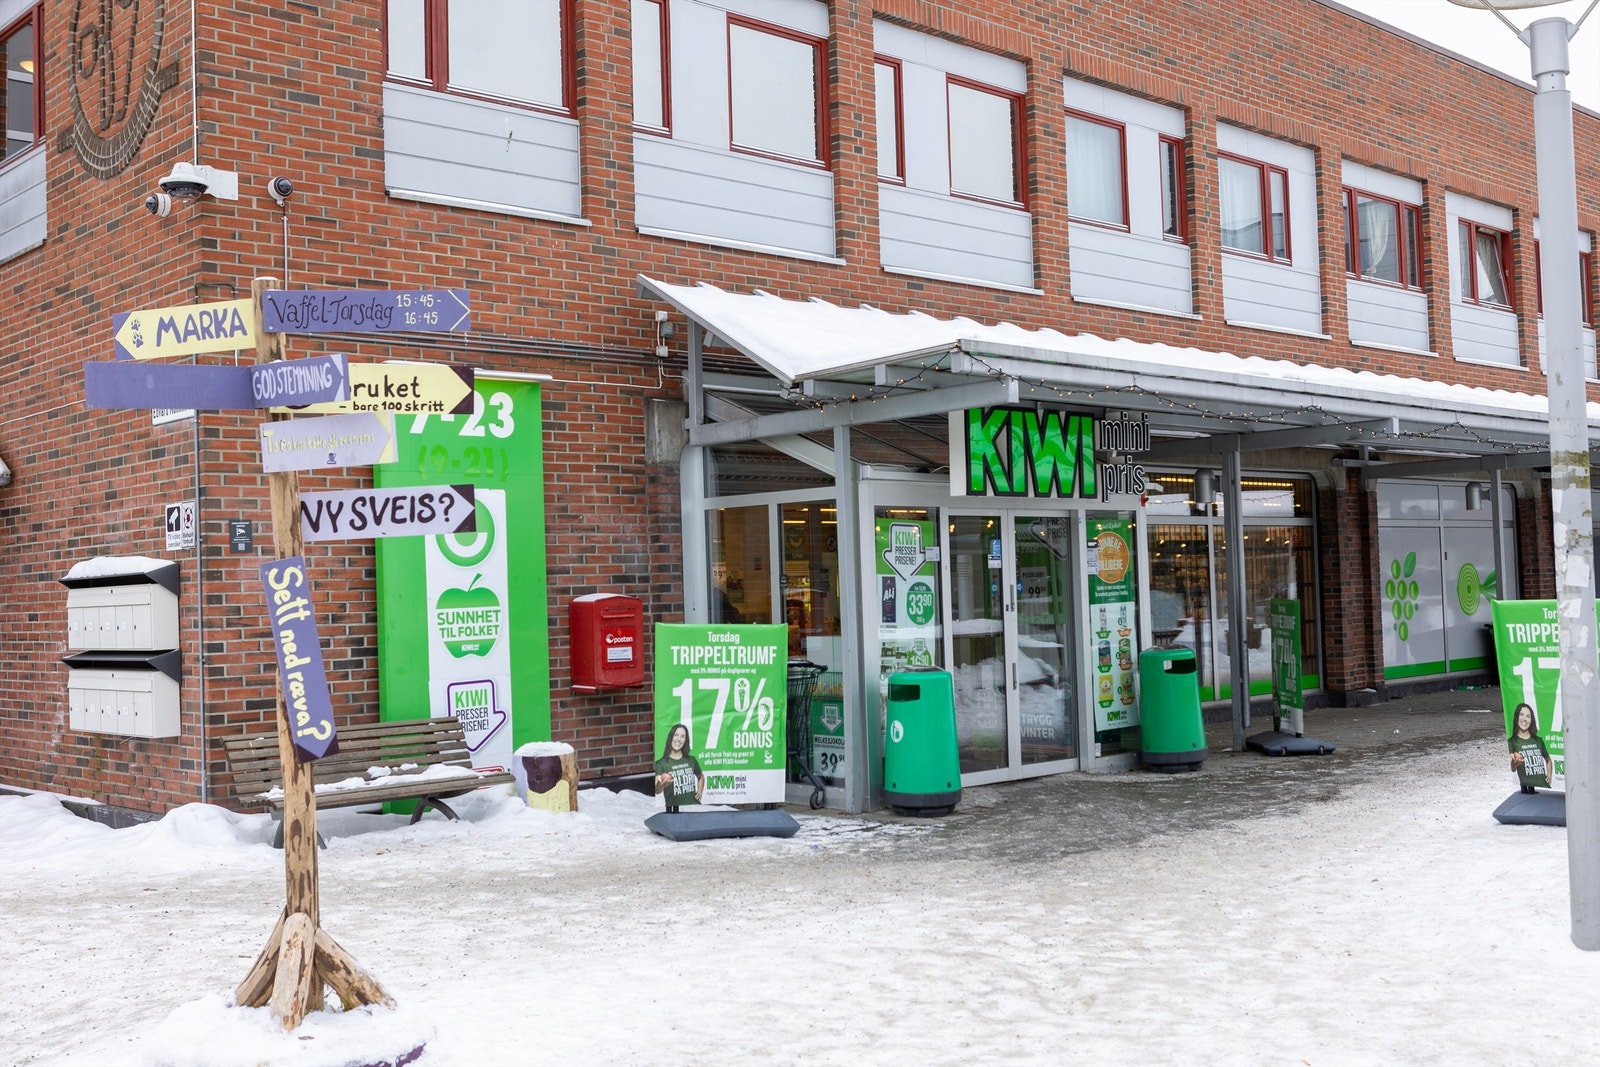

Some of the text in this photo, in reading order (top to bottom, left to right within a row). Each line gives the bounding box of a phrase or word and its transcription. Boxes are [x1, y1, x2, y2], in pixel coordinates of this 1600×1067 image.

[405, 311, 438, 325] 16:45
[156, 307, 248, 347] MARKA
[252, 369, 276, 400] GOD
[349, 375, 421, 398] ruket
[382, 401, 402, 411] 100
[404, 401, 444, 411] skritt
[1101, 411, 1150, 450] mini
[965, 408, 1098, 498] KIWI
[1102, 455, 1146, 502] pris
[301, 492, 455, 533] NY SVEIS?
[895, 531, 917, 545] KIWI
[895, 546, 917, 556] PRESSER
[269, 567, 311, 625] Sett
[437, 610, 501, 625] SUNNHET
[1542, 608, 1558, 619] Tor
[439, 625, 500, 638] TIL FOLKET
[707, 632, 740, 644] Torsdag
[280, 629, 311, 670] ned
[671, 646, 777, 665] TRIPPELTRUMF
[454, 689, 488, 708] KIWI
[456, 707, 489, 720] PRESSER
[673, 678, 774, 749] 17%
[1021, 714, 1052, 726] TRYGG
[462, 719, 490, 732] RISENE!
[733, 731, 773, 748] BONUS
[707, 775, 735, 790] KIWI
